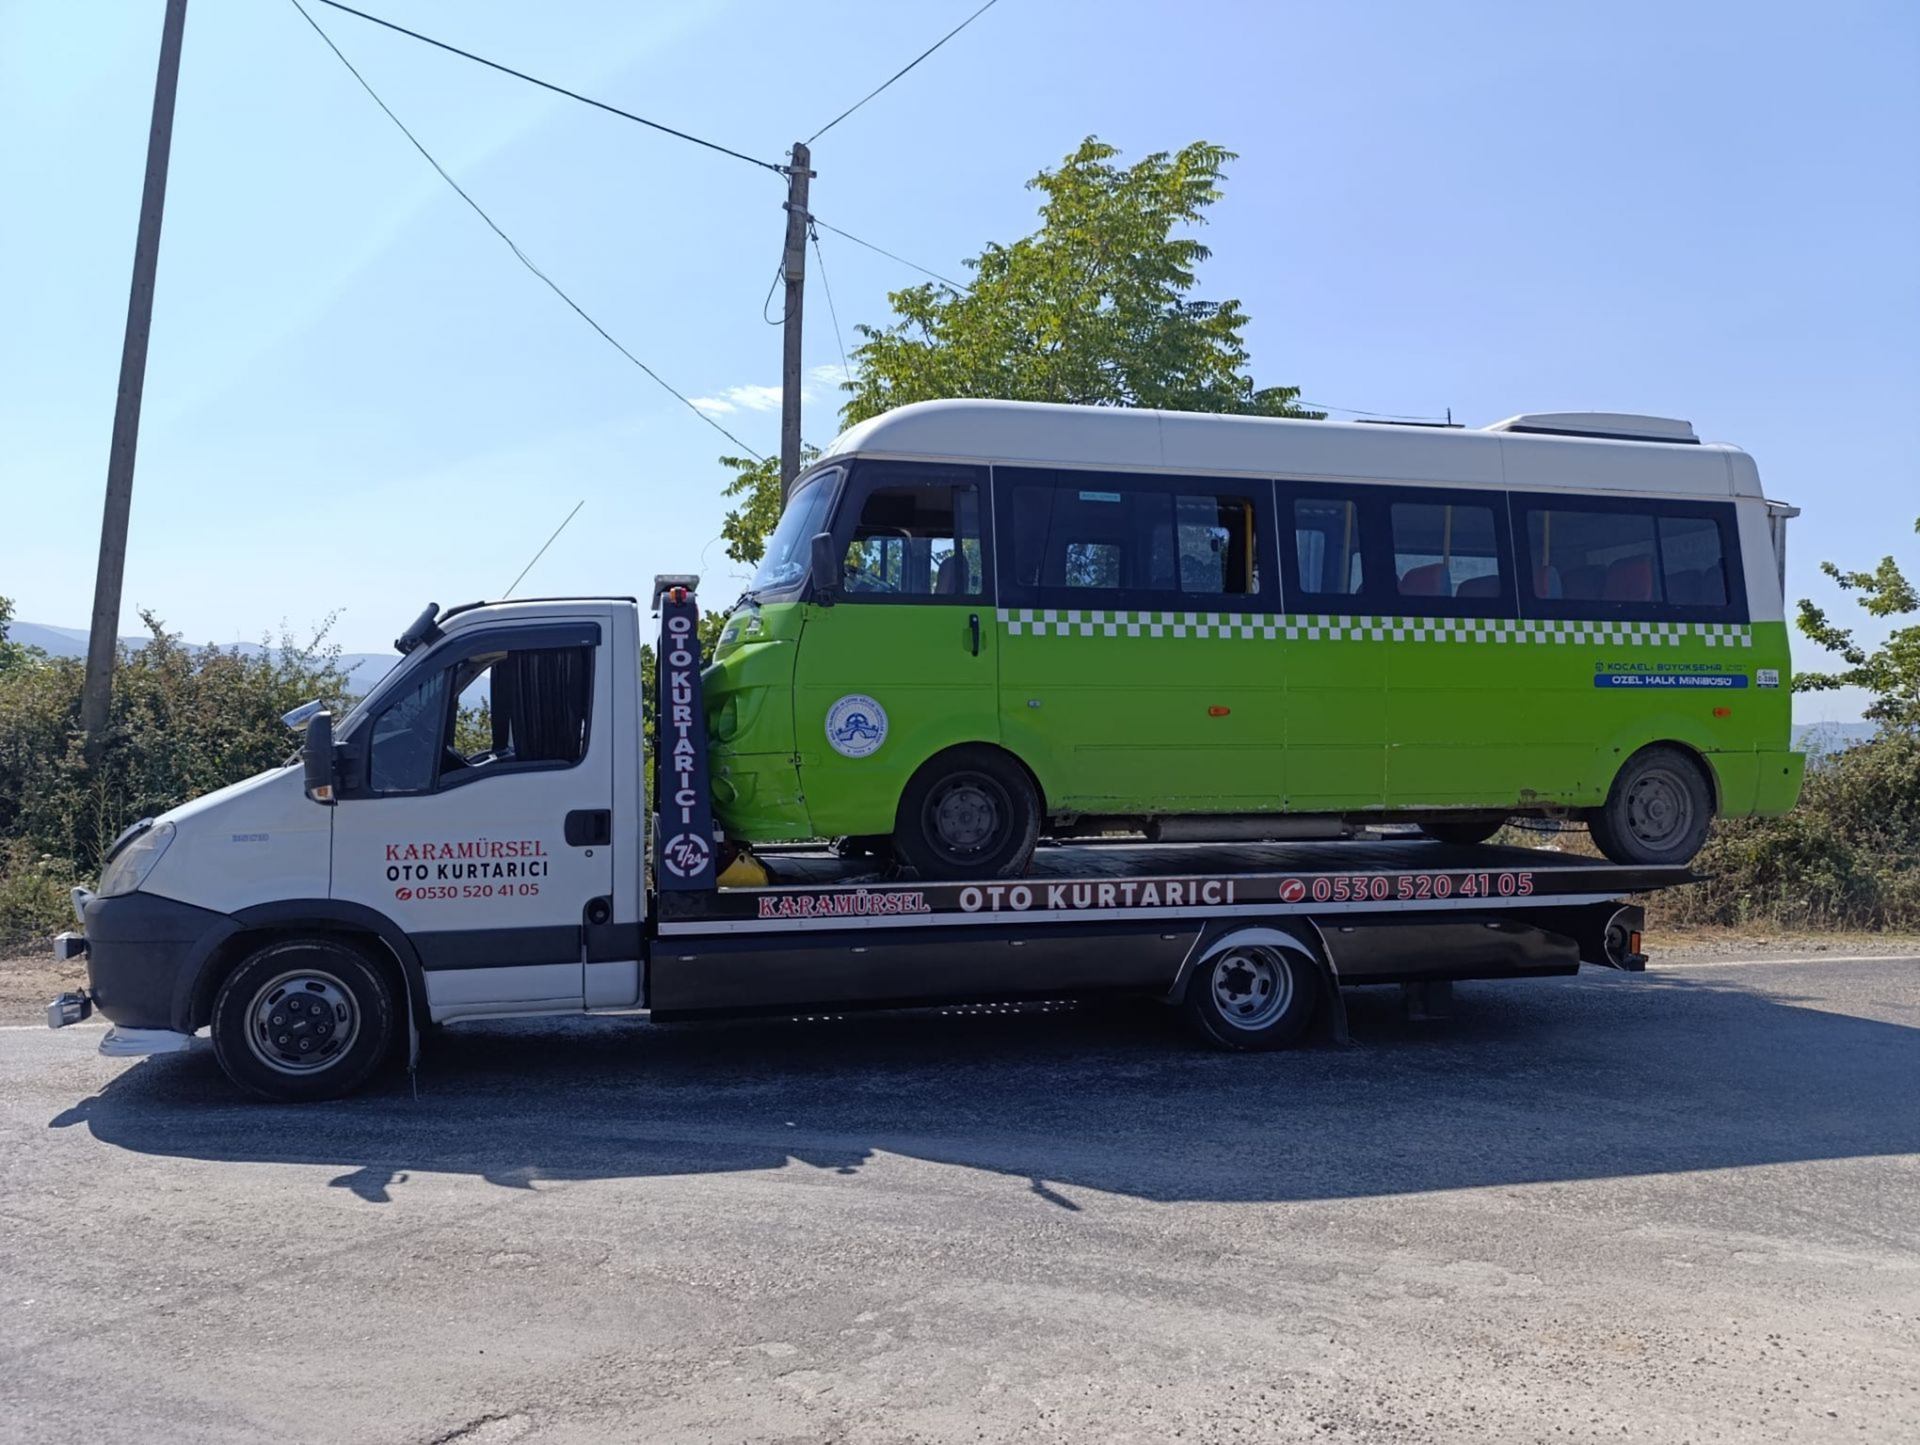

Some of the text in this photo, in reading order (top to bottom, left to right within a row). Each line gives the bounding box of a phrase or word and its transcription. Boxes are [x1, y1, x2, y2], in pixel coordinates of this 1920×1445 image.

[1645, 675, 1676, 686] HALK
[668, 616, 696, 824] OTO KURTARICI
[385, 837, 548, 862] KARAMÜRSEL
[386, 861, 549, 882] OTO KURTARICI
[415, 882, 540, 901] 0530 520 41 05
[757, 872, 1534, 919] KARAMÜRSEL OTO KURTARICI 0530 520 41 05
